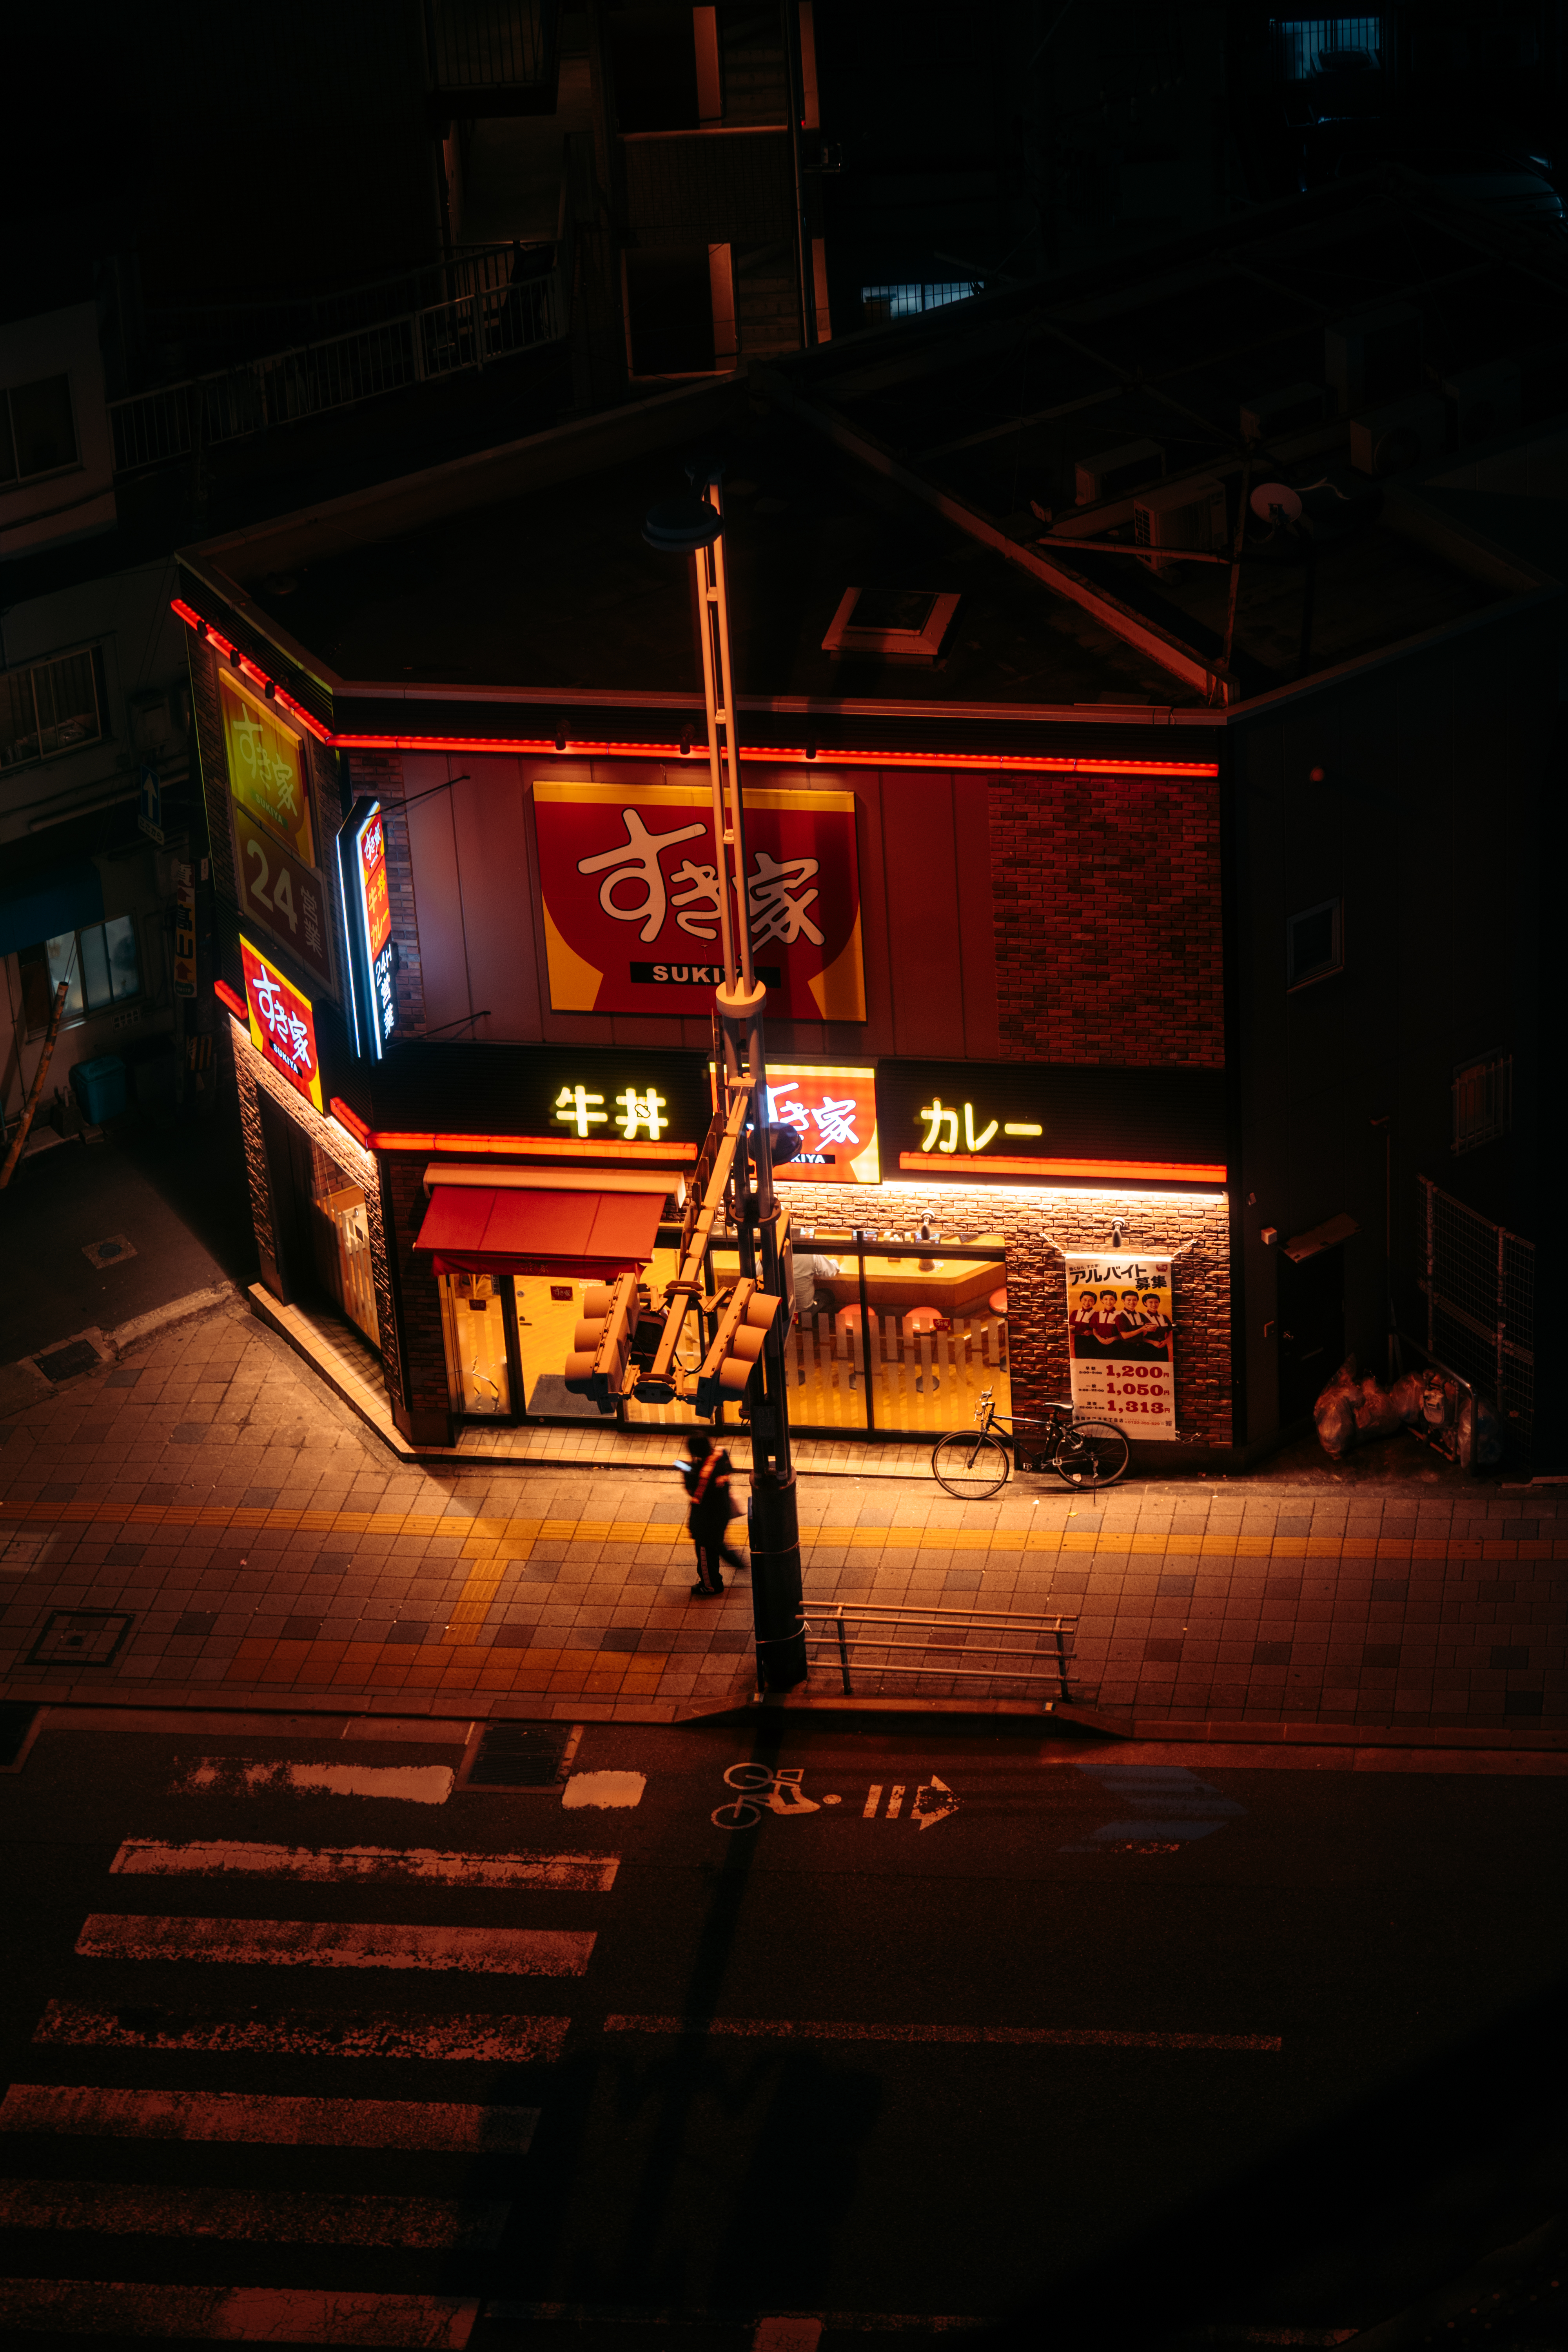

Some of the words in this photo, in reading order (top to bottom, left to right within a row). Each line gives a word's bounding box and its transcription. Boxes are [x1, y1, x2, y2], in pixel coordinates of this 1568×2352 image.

[233, 702, 298, 817] すき家
[140, 818, 162, 841] ここから
[256, 793, 283, 825] SUKIYA
[364, 822, 381, 861] すき家
[368, 868, 386, 914] 牛丼
[577, 808, 826, 962] すき家
[301, 885, 323, 958] 営業
[371, 907, 389, 953] カレー
[376, 944, 392, 987] 24H
[653, 965, 740, 984] SUKI
[252, 964, 312, 1069] すき家
[381, 973, 394, 1039] 営業
[273, 1043, 299, 1074] SUKIYA
[555, 1085, 668, 1140] 牛丼
[920, 1100, 1043, 1153] カレー
[790, 1154, 825, 1163] KIYA
[553, 1287, 571, 1296] すき家
[1070, 1264, 1147, 1286] アルバイト
[1135, 1275, 1167, 1291] 募集
